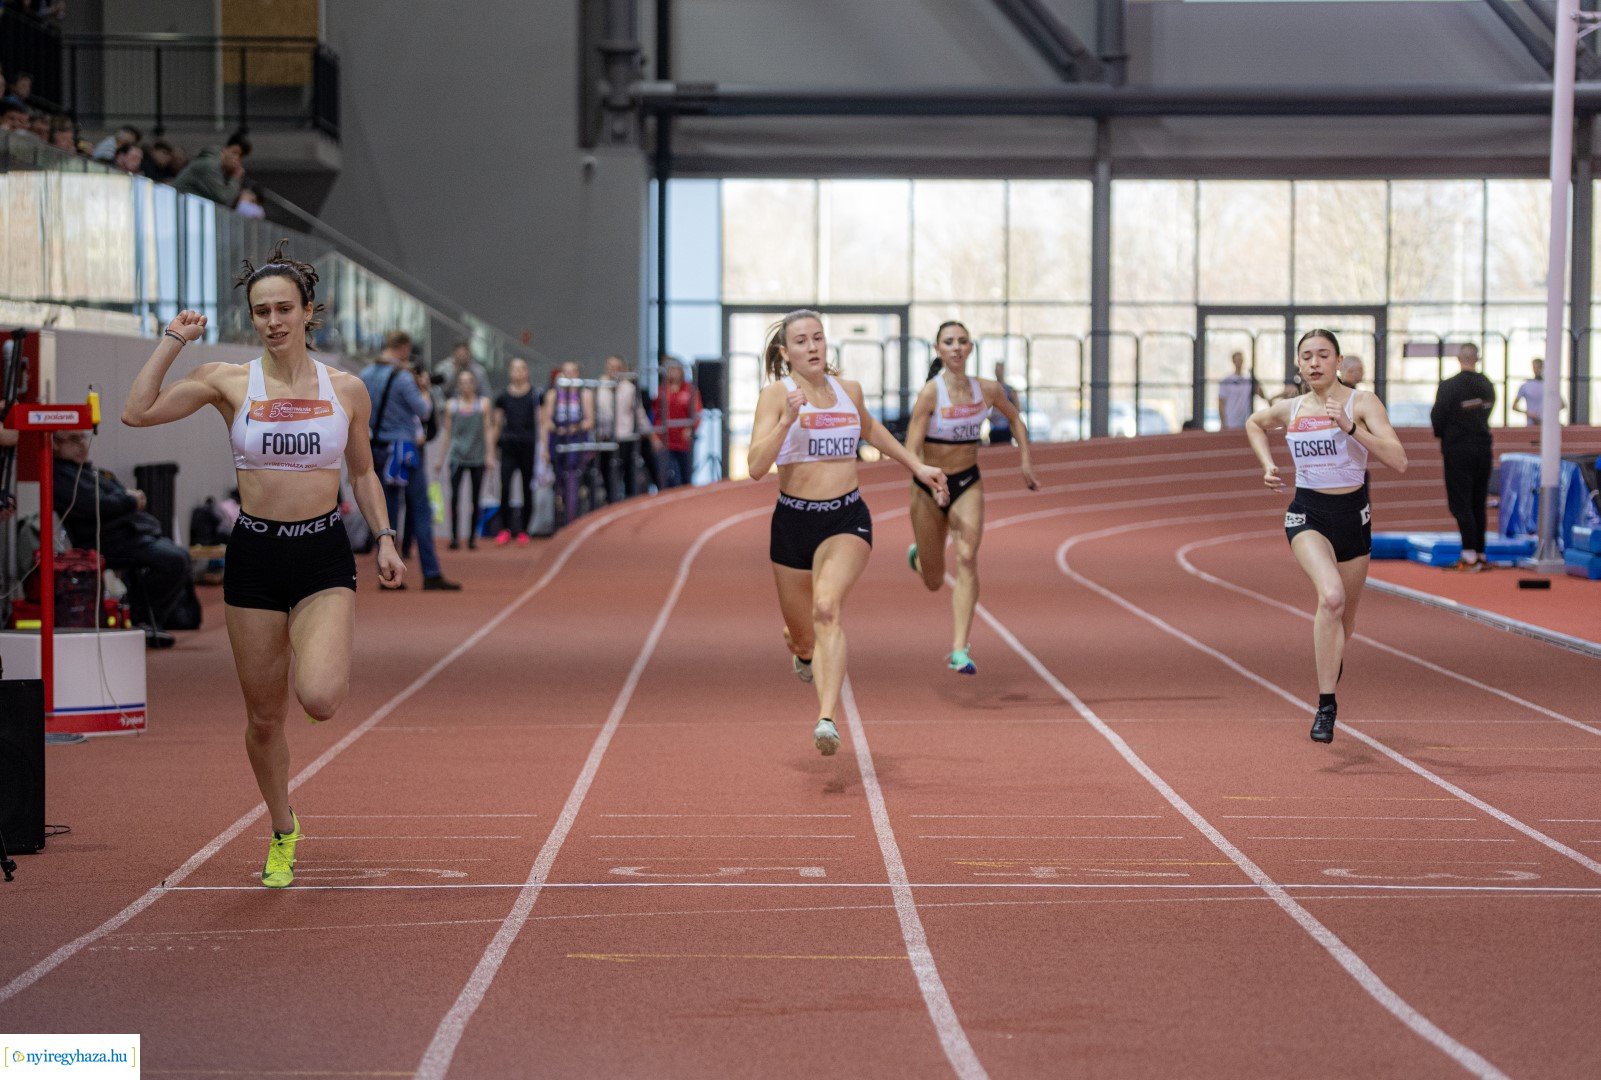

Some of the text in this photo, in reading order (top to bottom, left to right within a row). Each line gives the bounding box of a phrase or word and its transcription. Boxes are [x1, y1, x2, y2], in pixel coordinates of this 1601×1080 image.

[262, 432, 321, 455] FODOR
[808, 437, 855, 456] DECKER
[1294, 439, 1338, 458] ECSERI
[806, 501, 842, 512] PRO
[277, 518, 327, 537] NIKE
